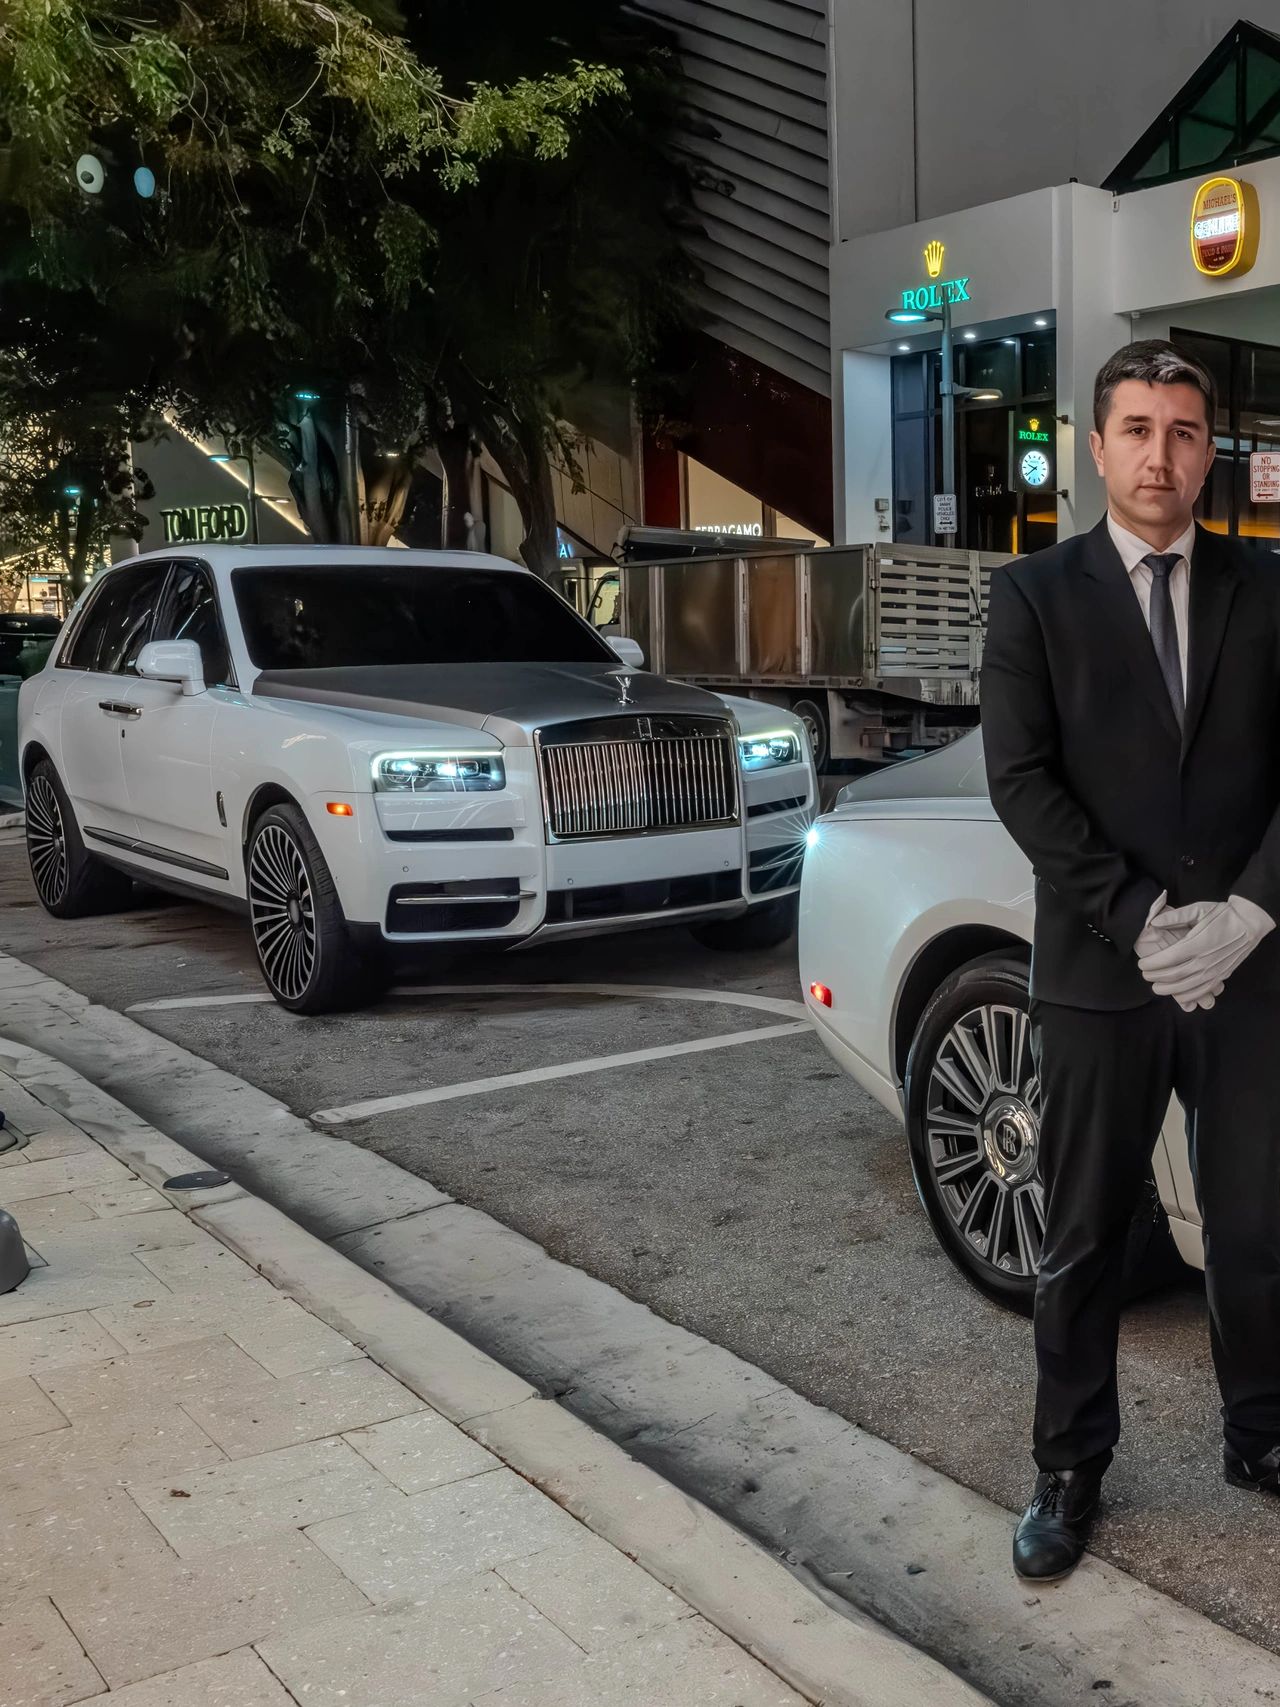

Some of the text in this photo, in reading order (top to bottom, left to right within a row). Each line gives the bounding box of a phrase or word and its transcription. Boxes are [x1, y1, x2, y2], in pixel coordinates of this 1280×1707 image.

[1203, 193, 1237, 210] MICHAEL'S
[902, 278, 971, 310] ROLEX
[1019, 430, 1049, 442] ROLEX
[1261, 456, 1272, 465] NO
[1253, 465, 1280, 473] STOPPING
[1262, 473, 1270, 481] OR
[160, 504, 248, 543] TOM FORD
